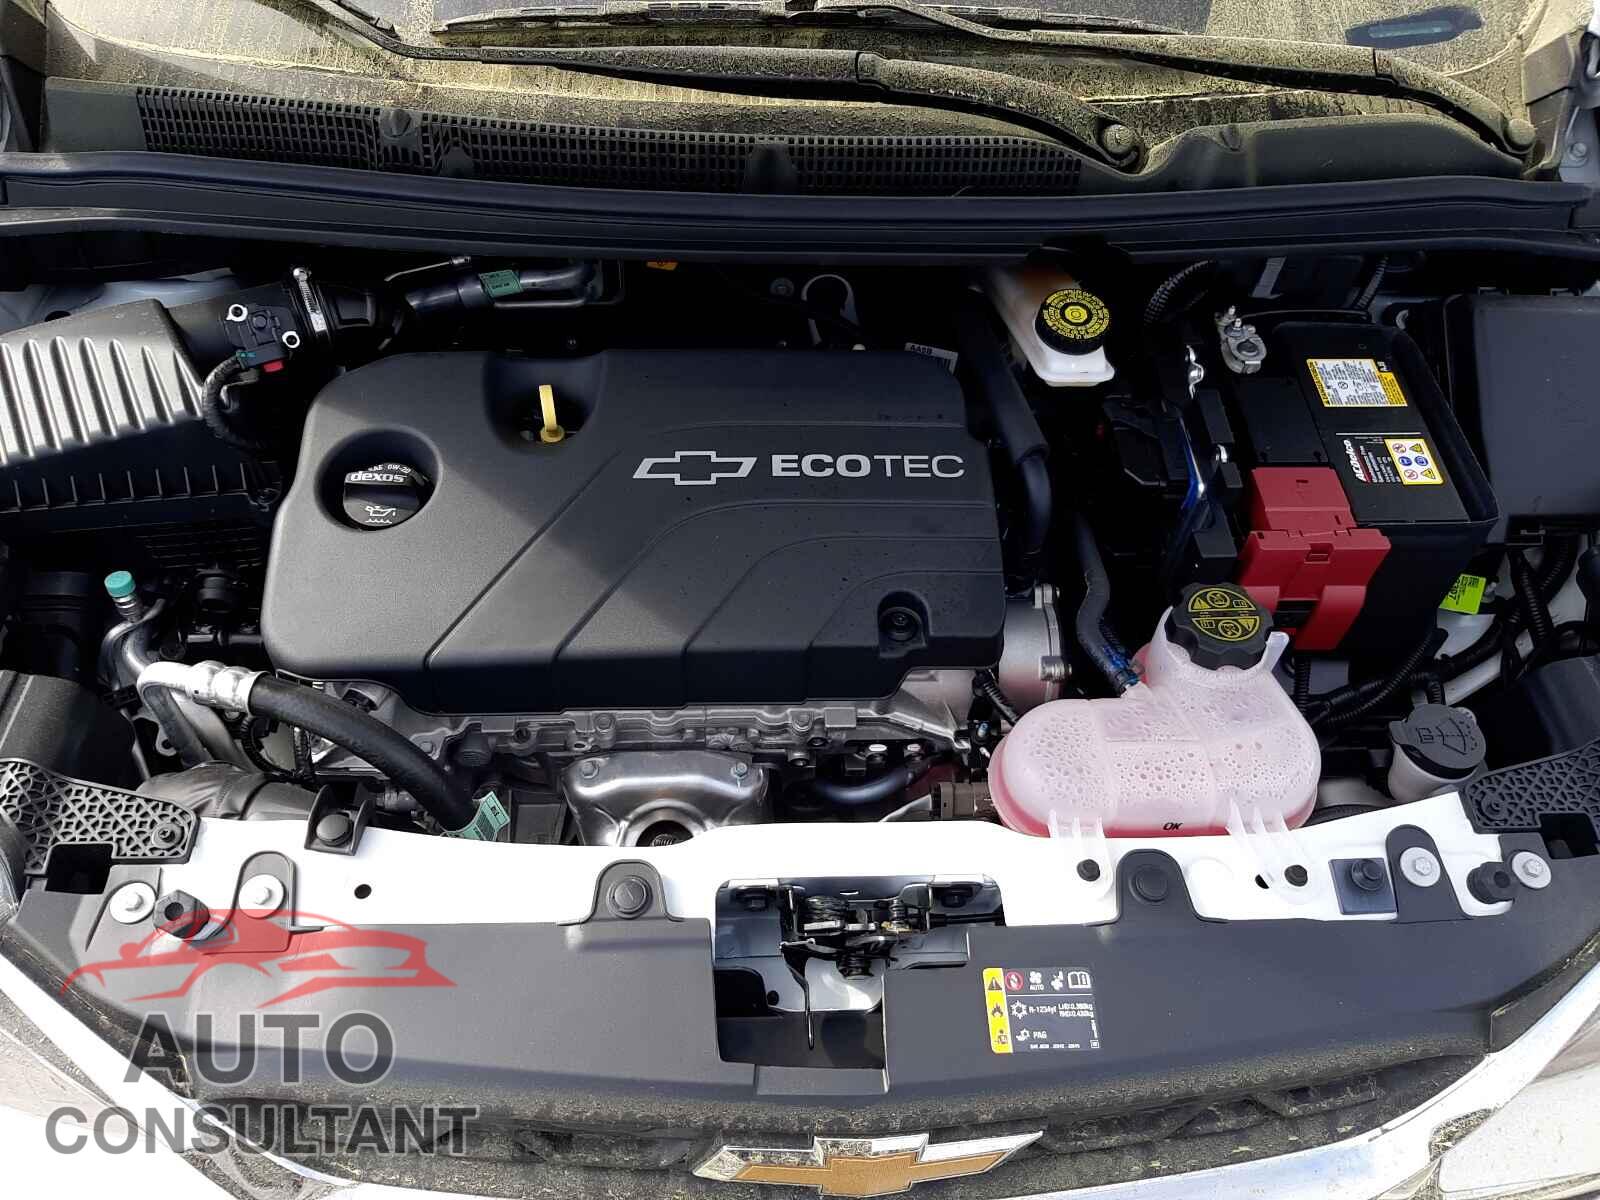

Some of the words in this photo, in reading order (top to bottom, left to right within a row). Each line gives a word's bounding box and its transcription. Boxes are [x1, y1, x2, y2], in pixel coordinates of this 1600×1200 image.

[771, 453, 965, 478] ECOTEC
[350, 470, 407, 483] dexos
[1163, 822, 1183, 831] OK
[1032, 1031, 1048, 1039] PAG
